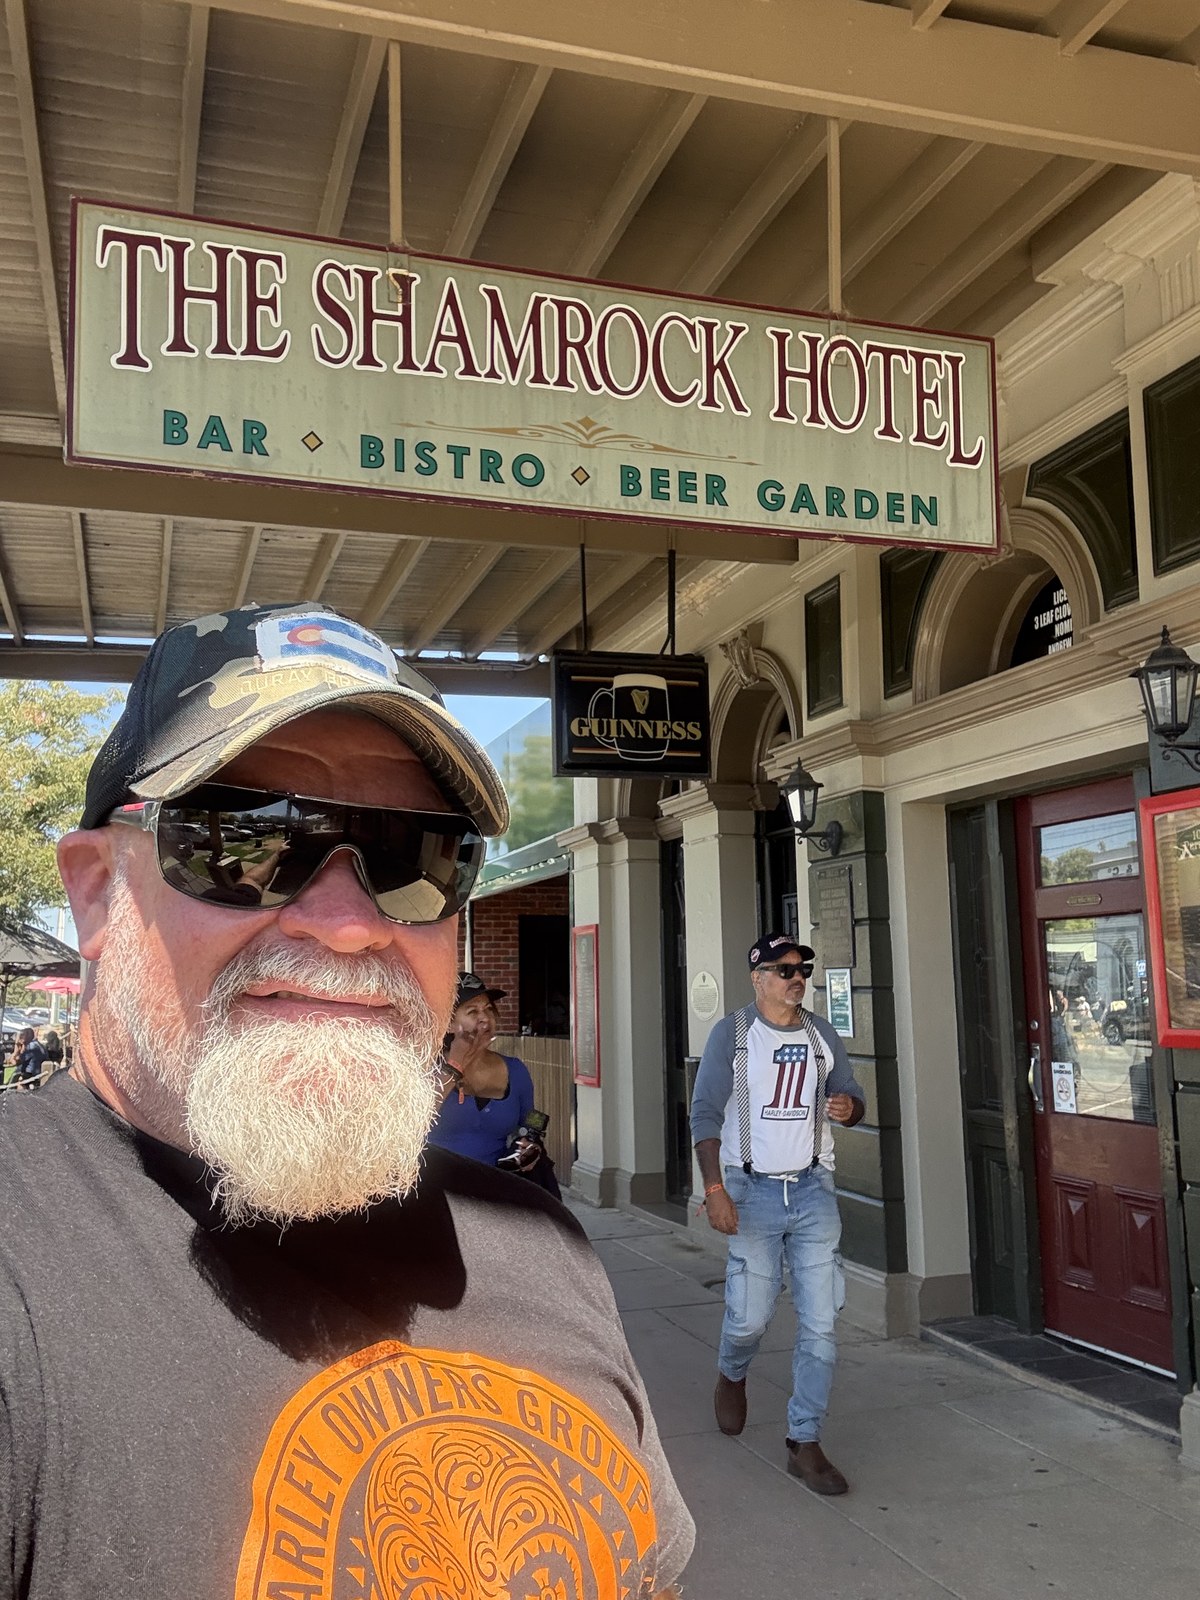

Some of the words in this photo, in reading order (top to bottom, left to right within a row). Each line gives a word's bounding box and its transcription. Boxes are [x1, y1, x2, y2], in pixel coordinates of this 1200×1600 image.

[97, 225, 291, 372] THE
[311, 258, 751, 418] SHAMROCK
[766, 325, 986, 470] HOTEL
[163, 409, 269, 457] BAR
[360, 434, 546, 488] BISTRO
[620, 464, 729, 507] BEER
[757, 479, 939, 528] GARDEN
[1034, 615, 1039, 630] 3
[1040, 609, 1054, 627] LEAF
[325, 671, 363, 690] BR
[570, 717, 702, 741] GUINNESS
[320, 1361, 502, 1454] OWNERS
[517, 1389, 650, 1515] GROUP
